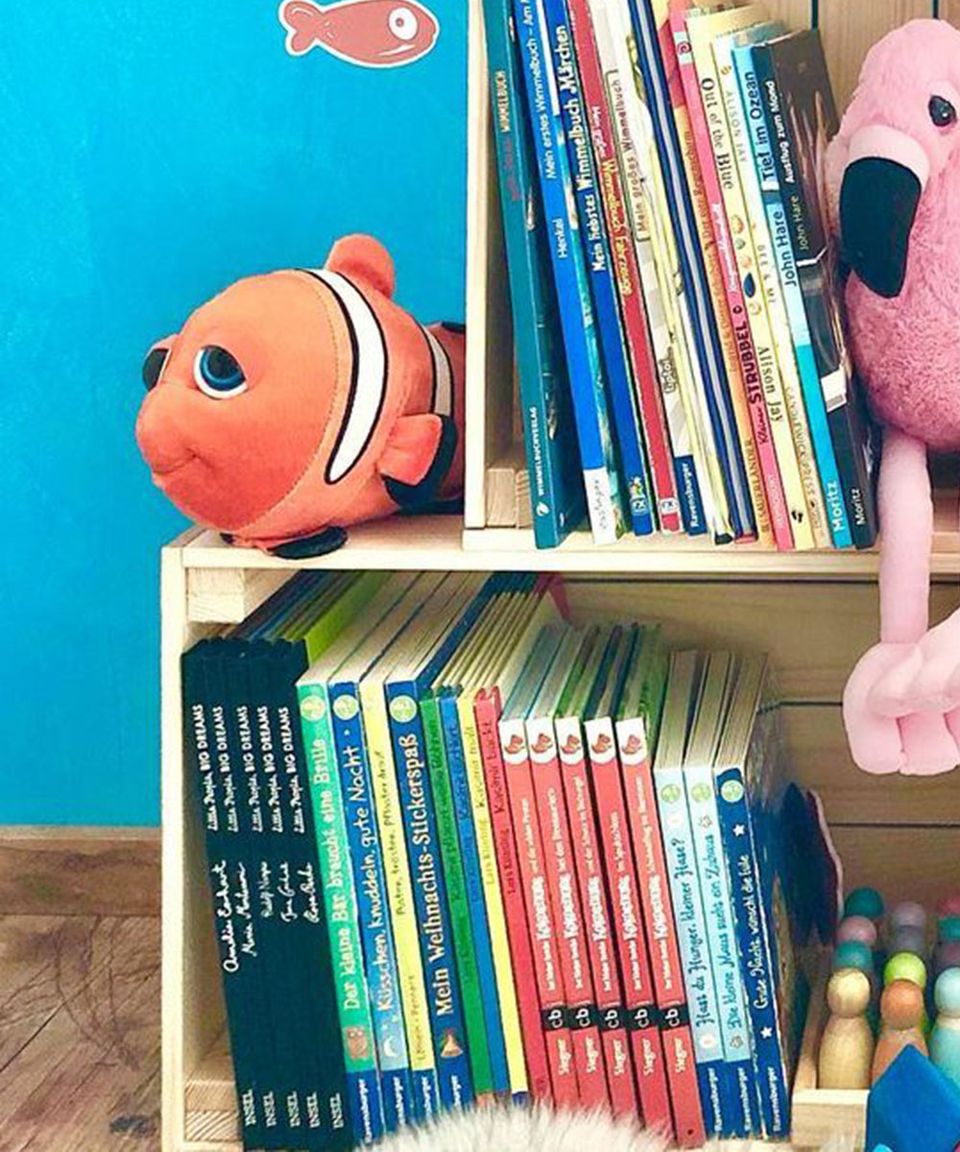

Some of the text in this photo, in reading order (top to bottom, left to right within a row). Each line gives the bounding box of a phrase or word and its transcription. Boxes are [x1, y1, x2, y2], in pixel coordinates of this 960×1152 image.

[523, 5, 534, 26] Am
[527, 38, 546, 111] Wimmelbuch
[555, 25, 577, 93] Märchen
[496, 71, 510, 132] WIMMELBUCH
[700, 77, 718, 108] Out
[539, 113, 552, 148] erstes
[709, 112, 722, 125] of
[726, 91, 742, 137] ALISON
[744, 71, 774, 181] Tief im Ozean
[765, 80, 794, 183] Ausflug zum Mond
[565, 98, 592, 190] Wimmelbuch
[612, 81, 646, 232] Mein großes Wimmelbuch
[711, 128, 724, 148] the
[544, 150, 556, 179] Mein
[716, 153, 732, 189] Blue
[553, 218, 567, 258] Henkel
[790, 195, 809, 250] John Hare
[591, 242, 606, 271] Mein
[773, 211, 797, 286] John Hare
[735, 321, 761, 404] STRUBBEL
[757, 346, 783, 422] Alison Jay
[682, 463, 699, 527] Ravensburger
[825, 482, 845, 532] Moritz
[851, 488, 865, 525] Moritz
[192, 704, 208, 749] DREAMS
[212, 706, 227, 750] DREAMS
[237, 706, 252, 750] DREAMS
[257, 706, 272, 751] DREAMS
[278, 707, 293, 751] DREAMS
[197, 751, 211, 771] BIG
[218, 753, 230, 772] BIG
[242, 752, 255, 772] BIG
[262, 752, 275, 773] BIG
[284, 753, 296, 773] BIG
[400, 735, 443, 960] Weihnachts-Stickerspaß
[671, 838, 693, 880] Hase?
[212, 860, 232, 917] Earhart
[309, 739, 360, 1010] Der kleine Bär braucht eine Brille
[343, 746, 394, 1011] Küsschen, knuddeln, gute Nacht
[711, 881, 722, 899] ein
[741, 877, 754, 893] die
[680, 882, 695, 922] kleiner
[717, 932, 735, 968] Maus
[432, 967, 451, 1015] Mein
[690, 975, 705, 991] du
[722, 972, 737, 1005] kleine
[753, 979, 768, 1009] Gute
[695, 994, 715, 1028] Hast
[726, 1007, 742, 1029] Die
[241, 1089, 256, 1126] INSEL
[263, 1091, 277, 1127] INSEL
[287, 1091, 300, 1127] INSEL
[306, 1091, 320, 1128] INSEL
[329, 1092, 343, 1128] INSEL
[708, 1067, 723, 1132] Ravensburger
[737, 1067, 752, 1131] Ravensburger
[767, 1066, 781, 1131] Ravensburger
